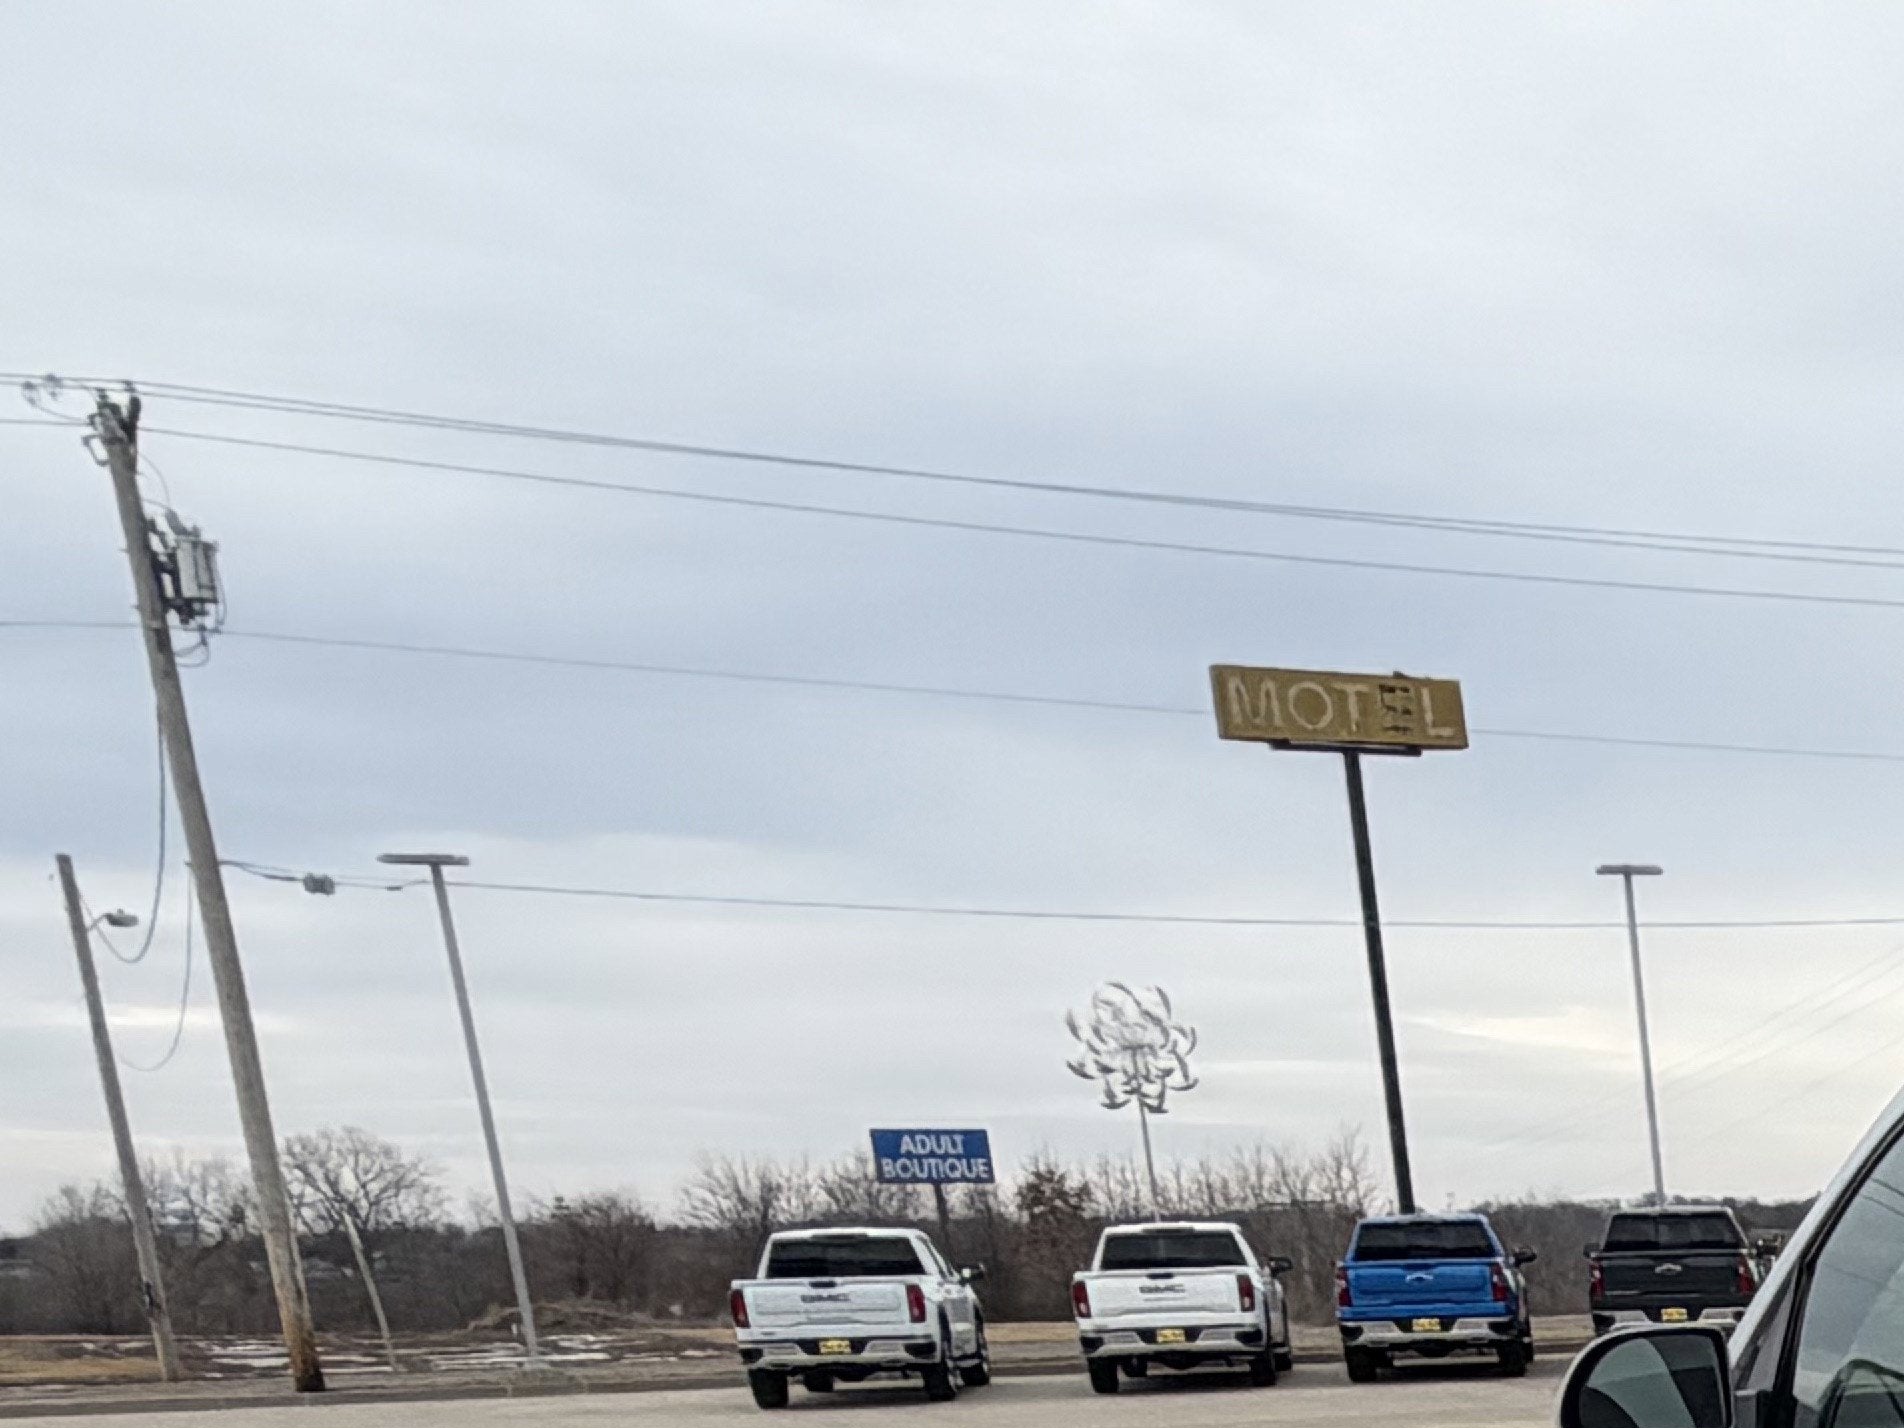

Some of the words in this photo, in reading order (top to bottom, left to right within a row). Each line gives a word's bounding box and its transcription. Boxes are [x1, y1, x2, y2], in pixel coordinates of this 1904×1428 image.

[1228, 676, 1455, 737] MOTEL
[900, 1134, 964, 1155] ADULT
[881, 1158, 990, 1179] BOUTIQUE
